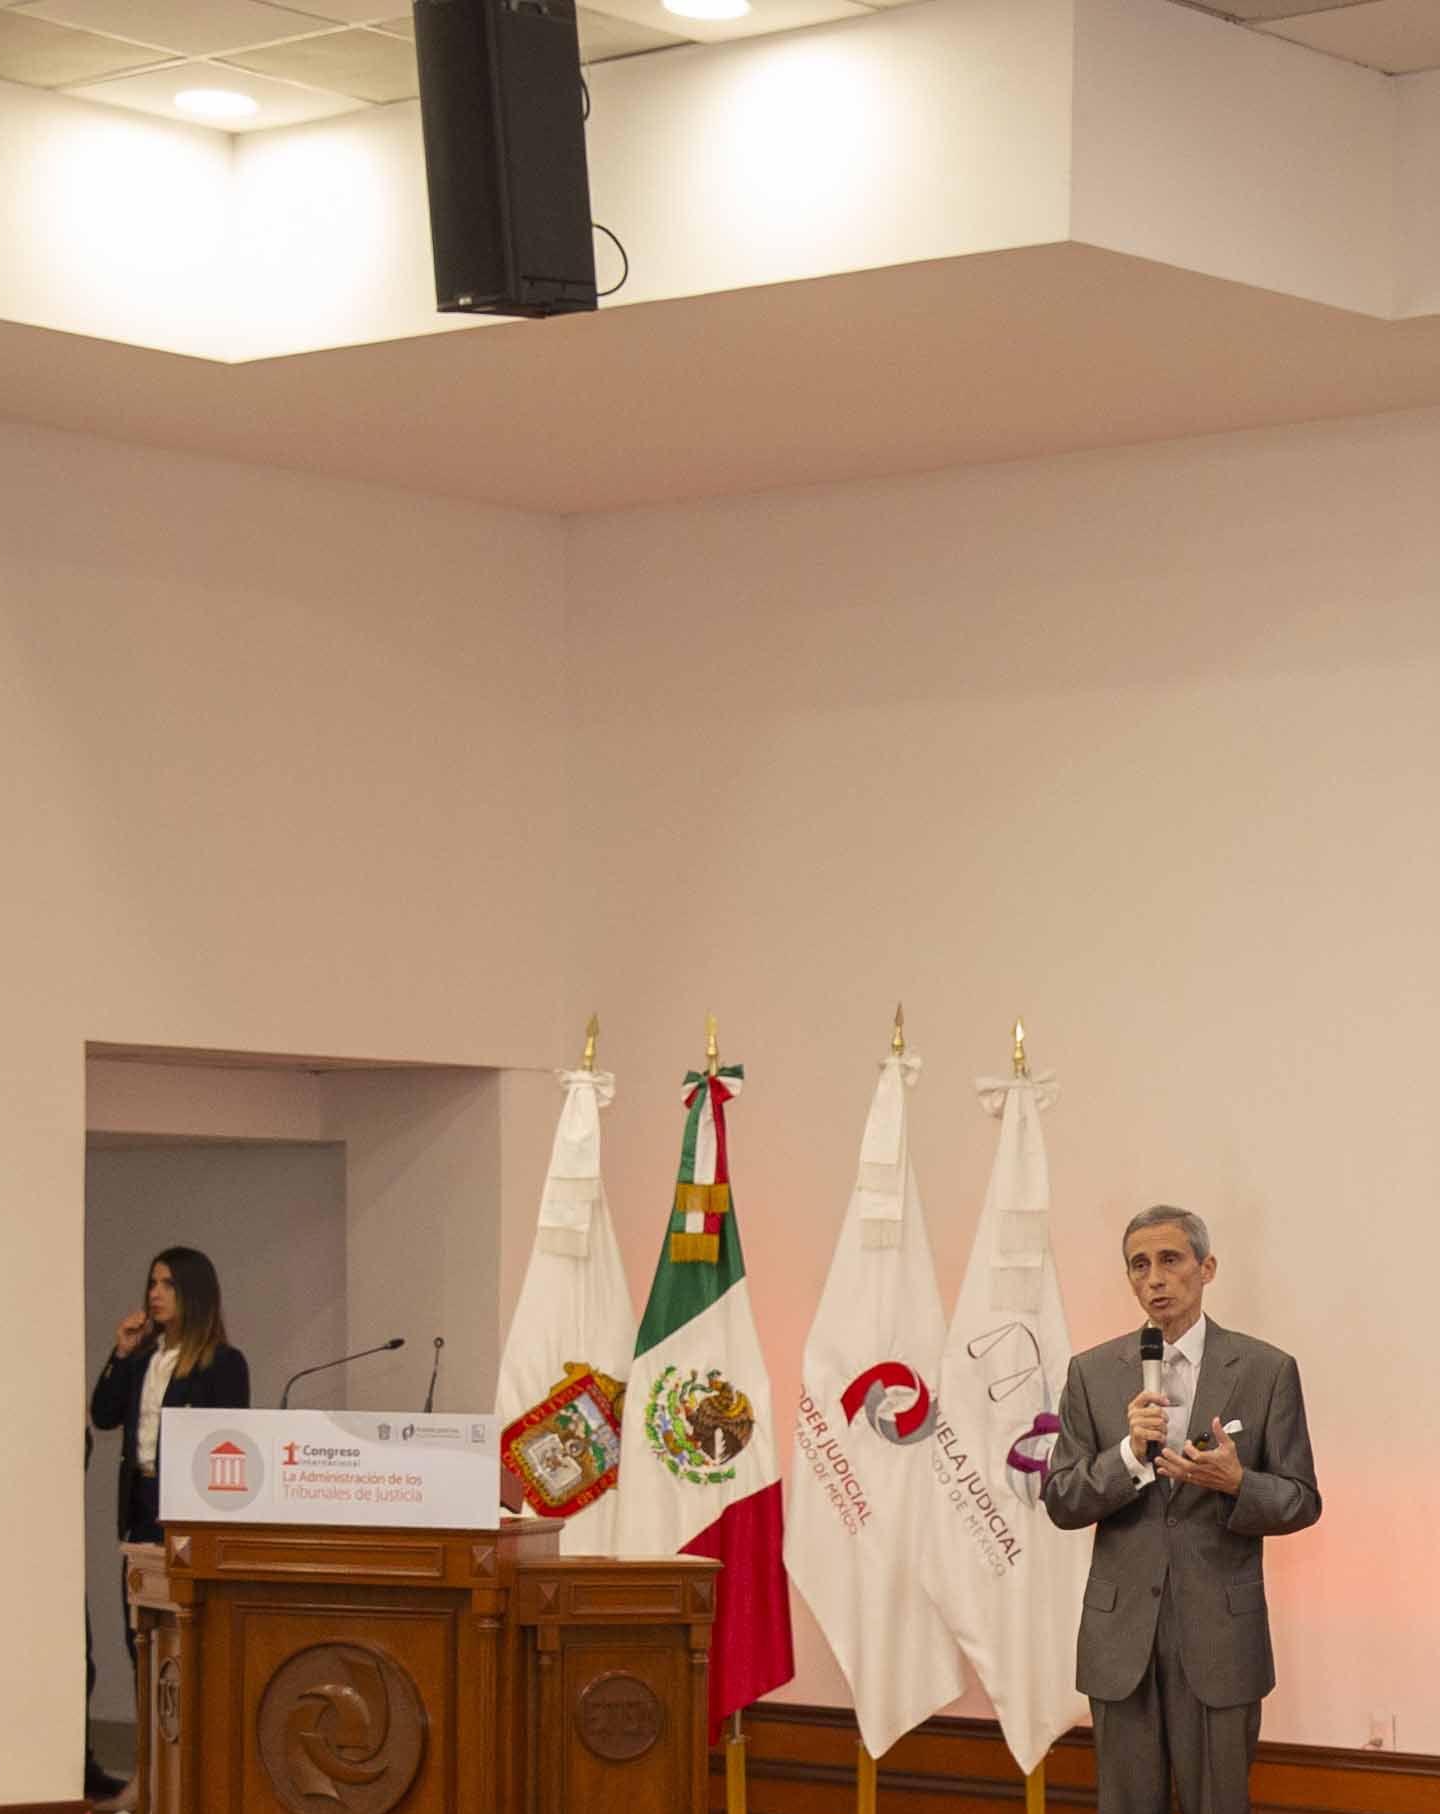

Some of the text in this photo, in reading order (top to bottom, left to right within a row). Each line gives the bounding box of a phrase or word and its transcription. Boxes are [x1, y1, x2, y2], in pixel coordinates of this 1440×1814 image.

[303, 1444, 361, 1460] Congreso
[282, 1471, 423, 1486] La Administración de los
[817, 1438, 872, 1526] JUDICIAL
[283, 1484, 423, 1503] Tribunales de Justicia
[936, 1411, 968, 1471] UELA
[959, 1471, 1022, 1566] JUDICIAL
